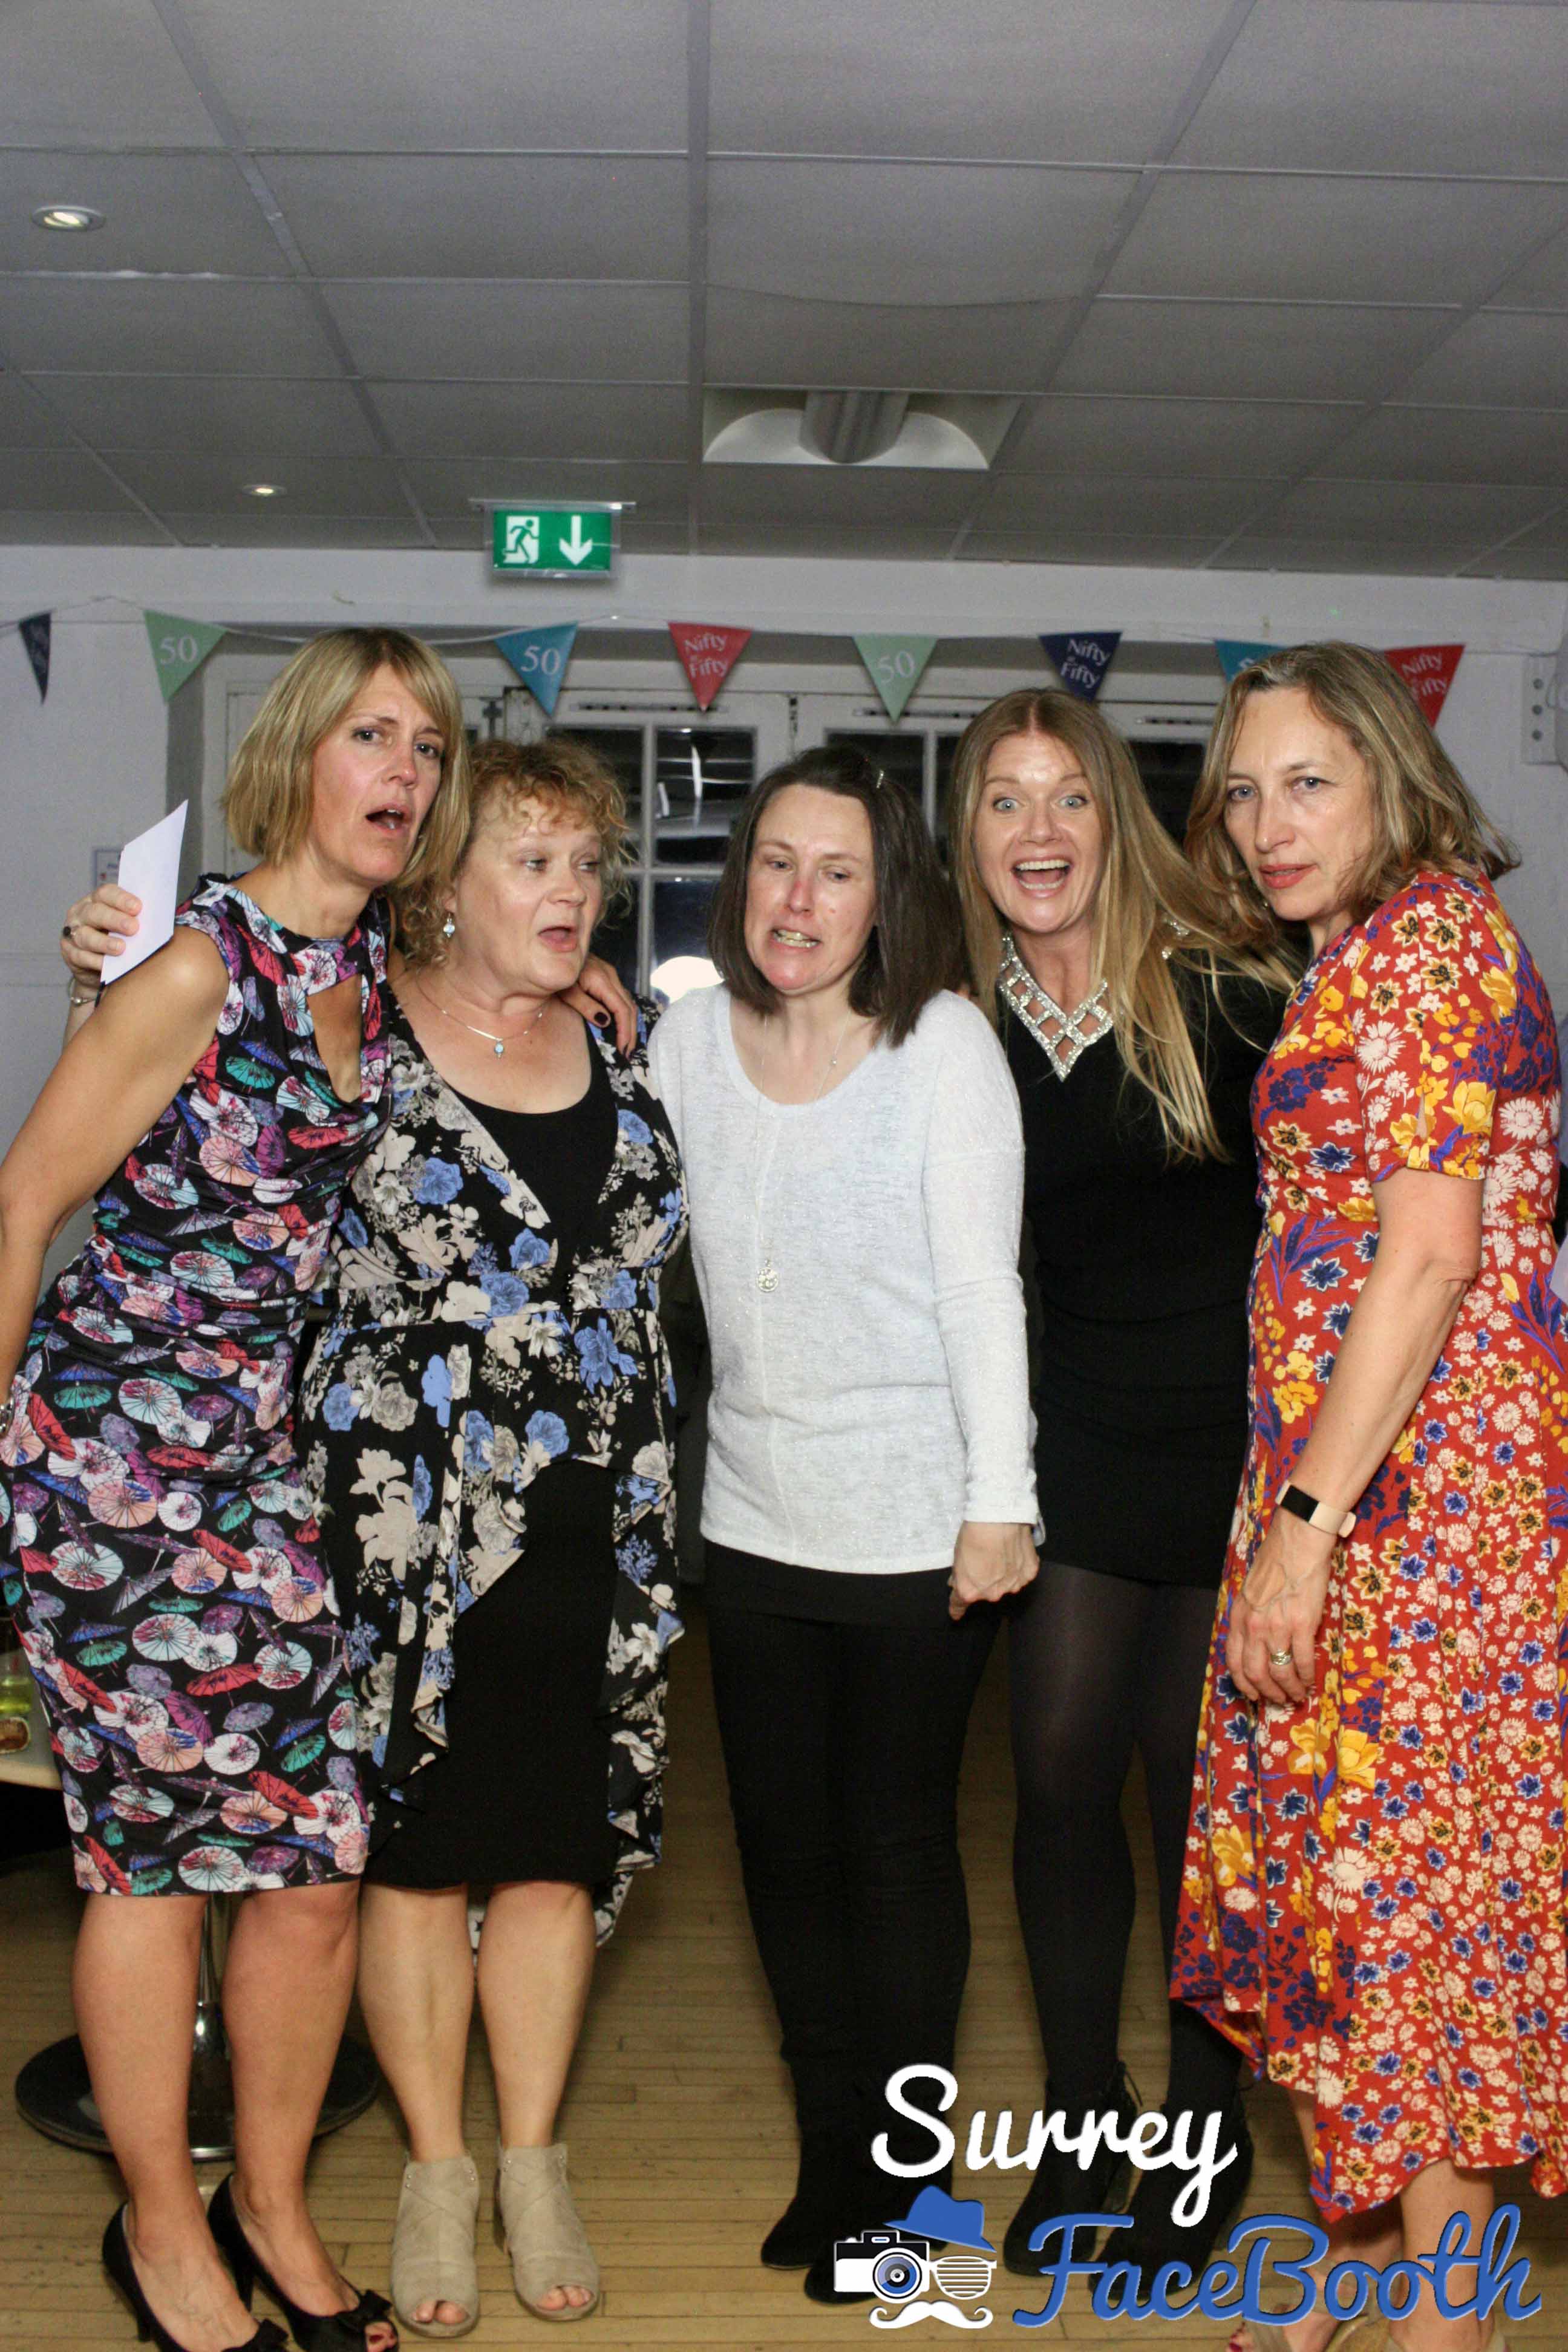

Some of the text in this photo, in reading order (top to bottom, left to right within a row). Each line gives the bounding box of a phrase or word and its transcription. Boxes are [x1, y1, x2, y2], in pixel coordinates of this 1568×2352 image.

[159, 635, 198, 664] 50
[684, 632, 728, 653] Nifty
[1067, 638, 1112, 667] Nifty
[520, 644, 561, 676] 50
[688, 656, 729, 678] Fifty
[875, 650, 915, 685] 50
[1400, 652, 1443, 677] Nifty
[1060, 661, 1100, 689] Fifty
